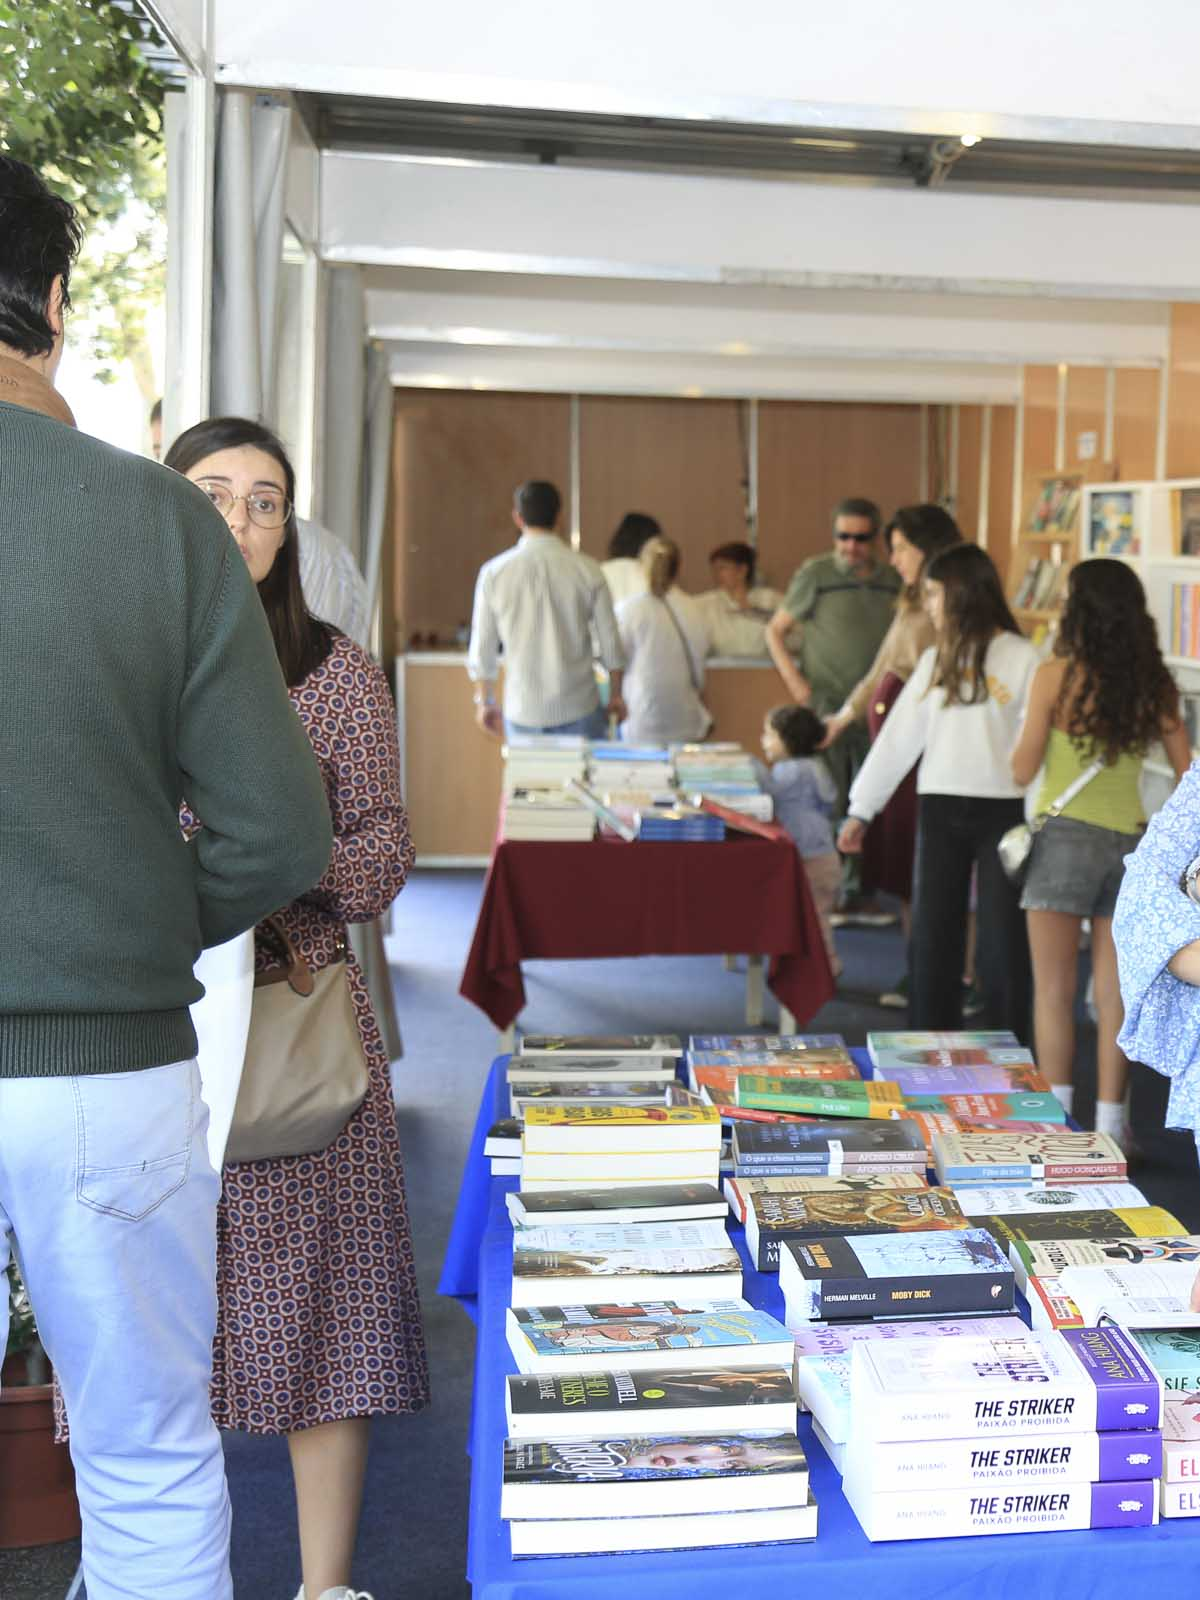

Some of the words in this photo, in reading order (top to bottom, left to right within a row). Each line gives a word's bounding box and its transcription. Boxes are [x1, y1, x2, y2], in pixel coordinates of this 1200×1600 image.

[824, 1294, 846, 1302] HERMAN
[848, 1293, 876, 1302] MELVILLE
[891, 1290, 911, 1300] MOBY
[912, 1289, 931, 1299] DICK
[1081, 1332, 1116, 1359] HUANG
[1102, 1360, 1129, 1379] ANA
[1165, 1377, 1189, 1391] SIE
[975, 1401, 1005, 1418] THE
[1008, 1397, 1075, 1416] STRIKER
[977, 1418, 1016, 1428] PAIXÃO
[1021, 1417, 1070, 1426] PROIBIDA
[971, 1450, 1001, 1468] THE
[1004, 1447, 1071, 1467] STRIKER
[1017, 1466, 1067, 1476] PROIBIDA
[970, 1497, 1000, 1516] THE
[1003, 1494, 1070, 1513] STRIKER
[973, 1515, 1013, 1526] PAIXÃO
[1016, 1512, 1066, 1524] PROIBIDA
